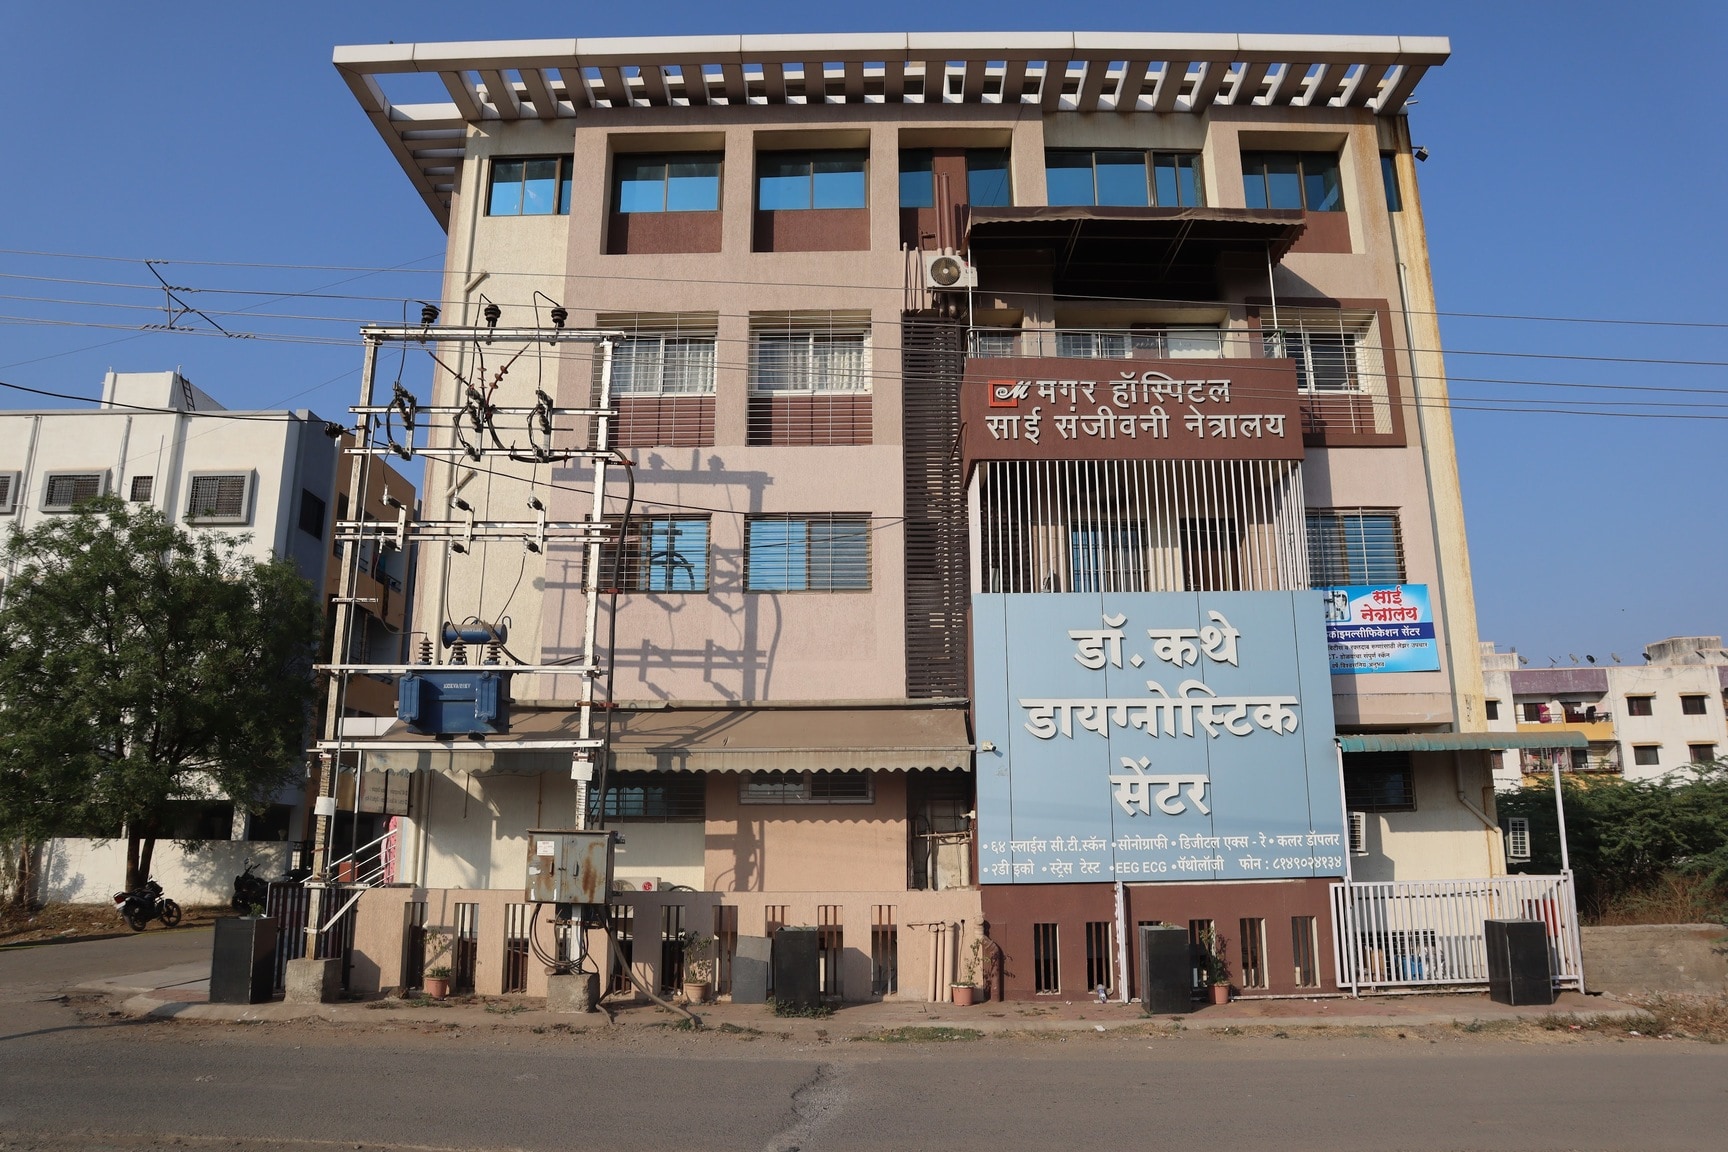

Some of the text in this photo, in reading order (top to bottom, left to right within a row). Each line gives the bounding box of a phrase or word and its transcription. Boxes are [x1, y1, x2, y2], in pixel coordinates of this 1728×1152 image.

[1035, 371, 1232, 408] मगर हॉस्पिटल
[985, 405, 1286, 444] साई संजीवनी नेत्रालय
[1372, 585, 1402, 606] साई
[1360, 604, 1418, 622] नेत्रालय
[1068, 610, 1241, 669] डॉ. कथे
[1328, 625, 1421, 640] कोइमल्सीफिकेशन सेंटर
[1018, 679, 1299, 739] डायग्नोस्टिक
[1108, 756, 1210, 816] सेंटर
[991, 840, 1006, 854] ६४
[1010, 836, 1047, 855] स्लाईस
[1117, 834, 1168, 851] सोनोग्राफी
[1179, 833, 1220, 850] डिजीटल
[1276, 835, 1303, 848] कलर
[1306, 830, 1340, 847] डॉपलर
[1012, 858, 1035, 877] इको
[1049, 858, 1073, 878] स्ट्रेस
[1079, 858, 1101, 874] टेस्ट
[1116, 862, 1140, 874] EEG
[1142, 861, 1167, 873] ECG
[1177, 855, 1225, 872] पॅथोलॉजी
[1238, 854, 1262, 871] फोन
[1273, 855, 1342, 871] ८१४९०२४१३४
